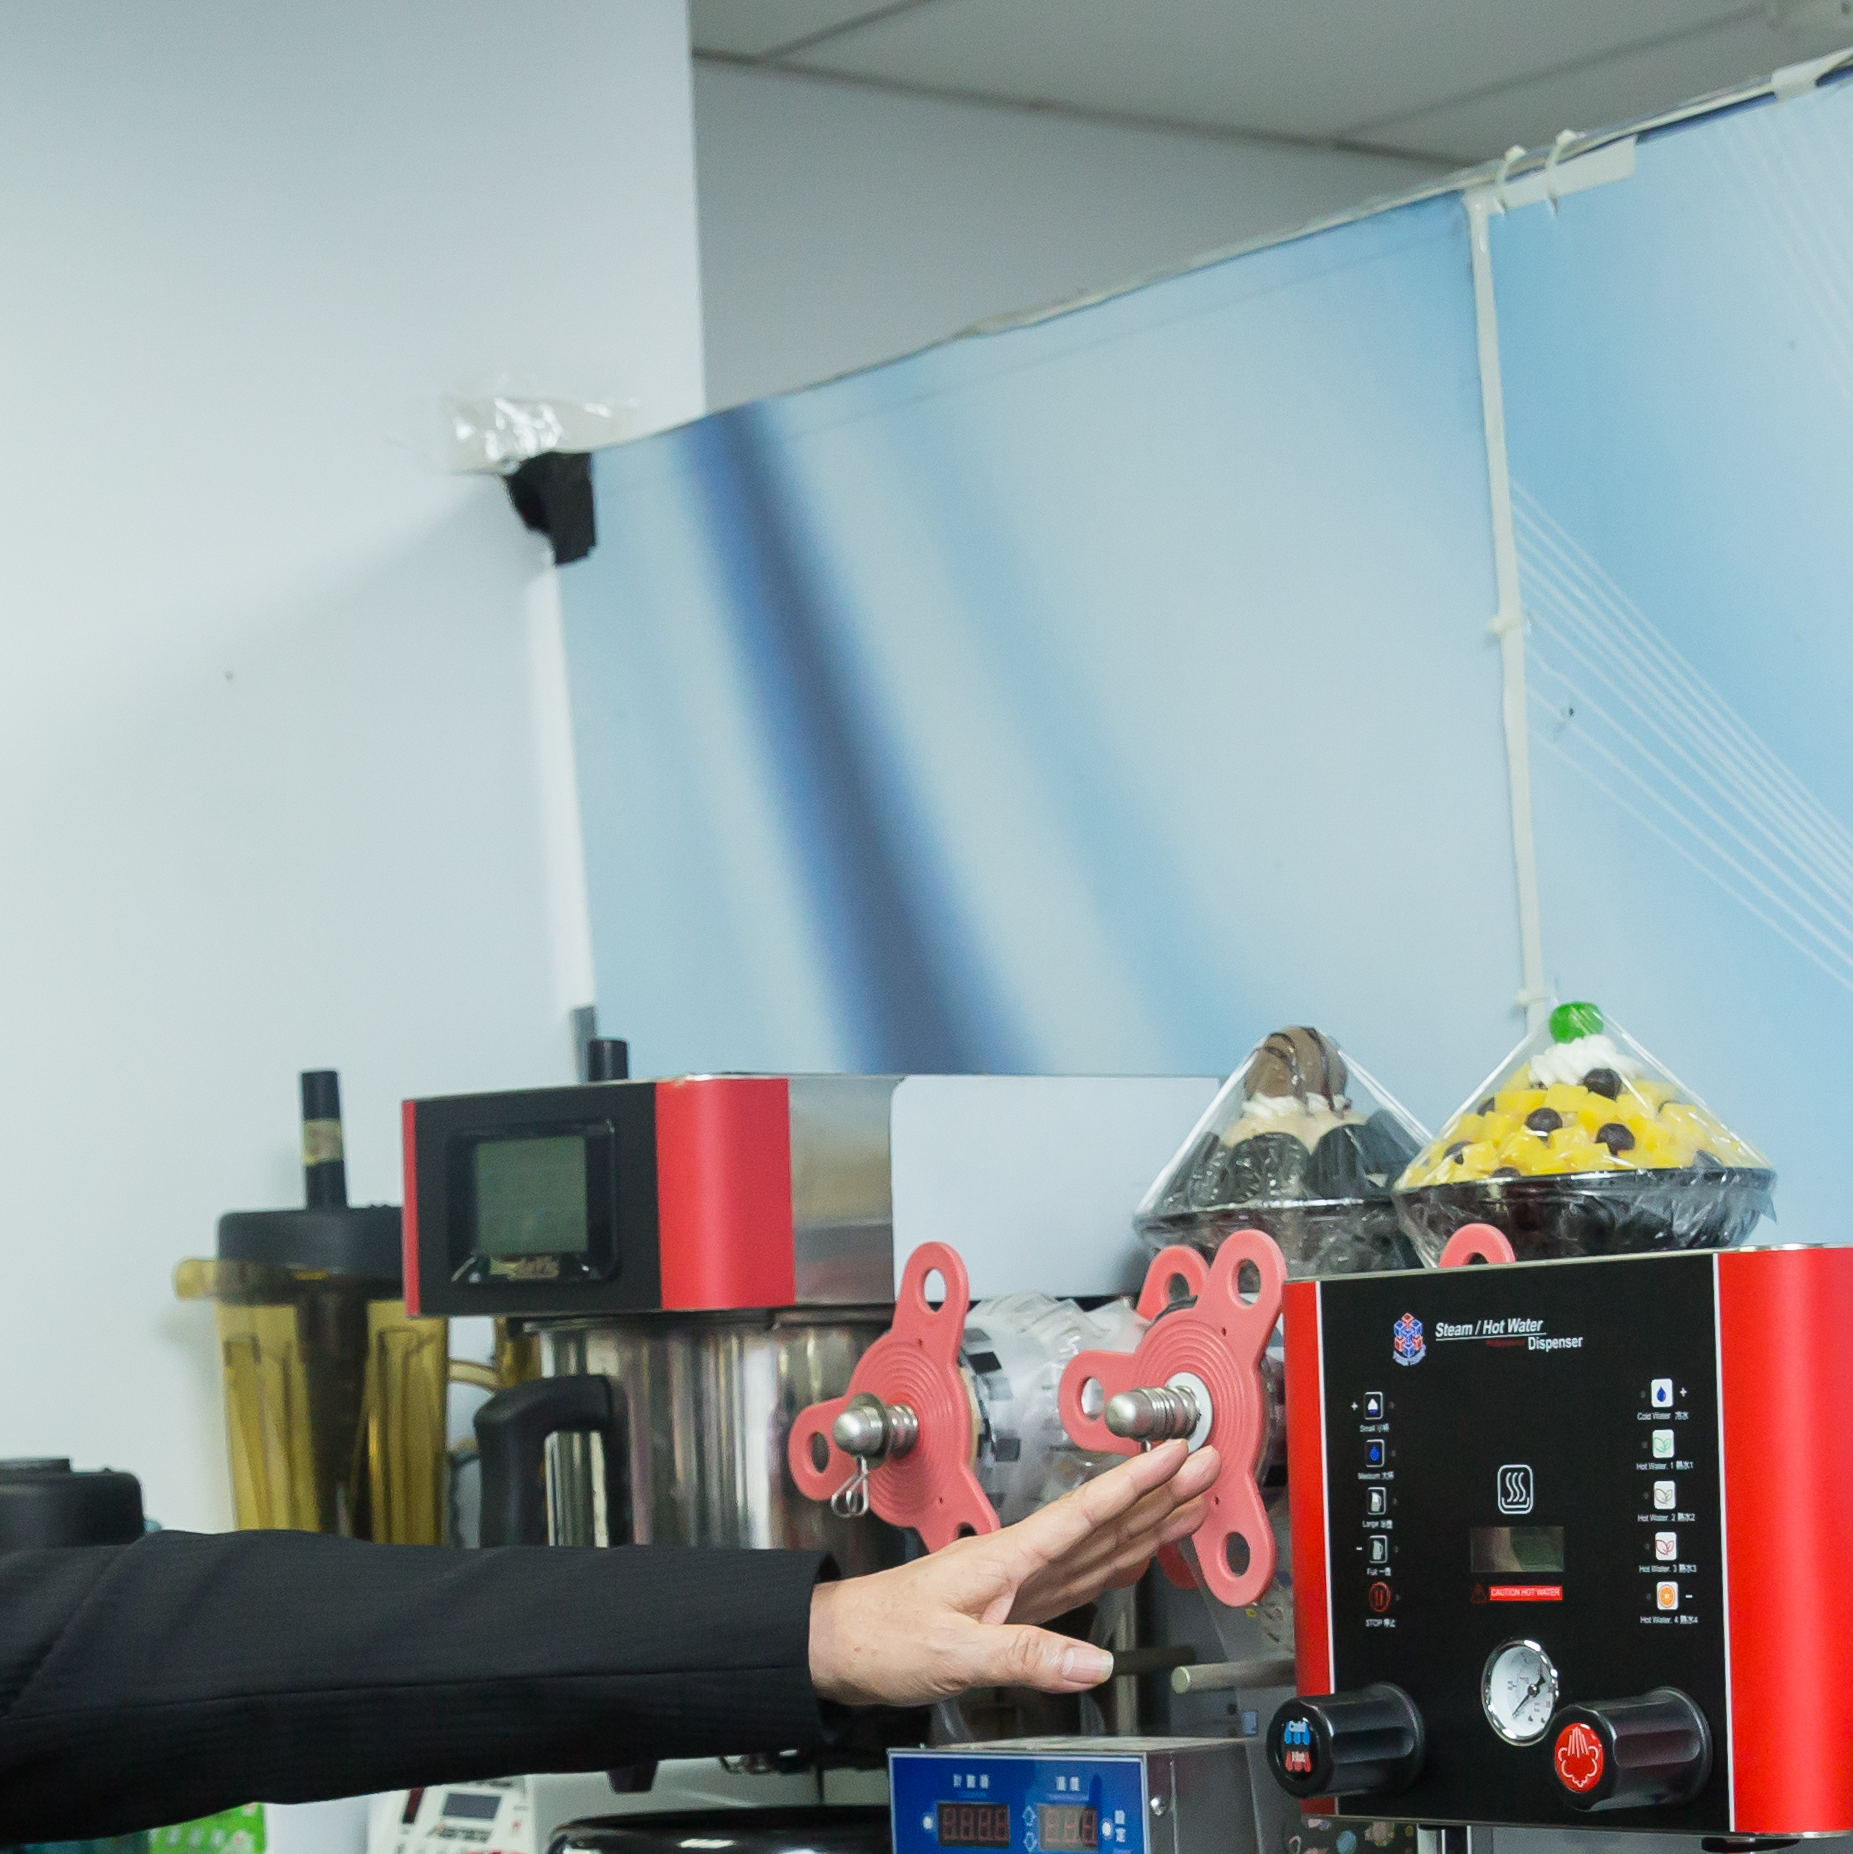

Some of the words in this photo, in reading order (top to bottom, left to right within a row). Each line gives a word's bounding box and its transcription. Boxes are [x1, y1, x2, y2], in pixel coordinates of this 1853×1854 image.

[1435, 1322, 1472, 1338] Steam
[1482, 1319, 1504, 1335] Hot
[1507, 1318, 1544, 1333] Water
[1527, 1336, 1584, 1353] Dispenser
[1491, 1587, 1520, 1597] CAUTION
[1522, 1588, 1536, 1597] HOT
[1537, 1588, 1561, 1597] WATER
[1366, 1618, 1382, 1628] STOP
